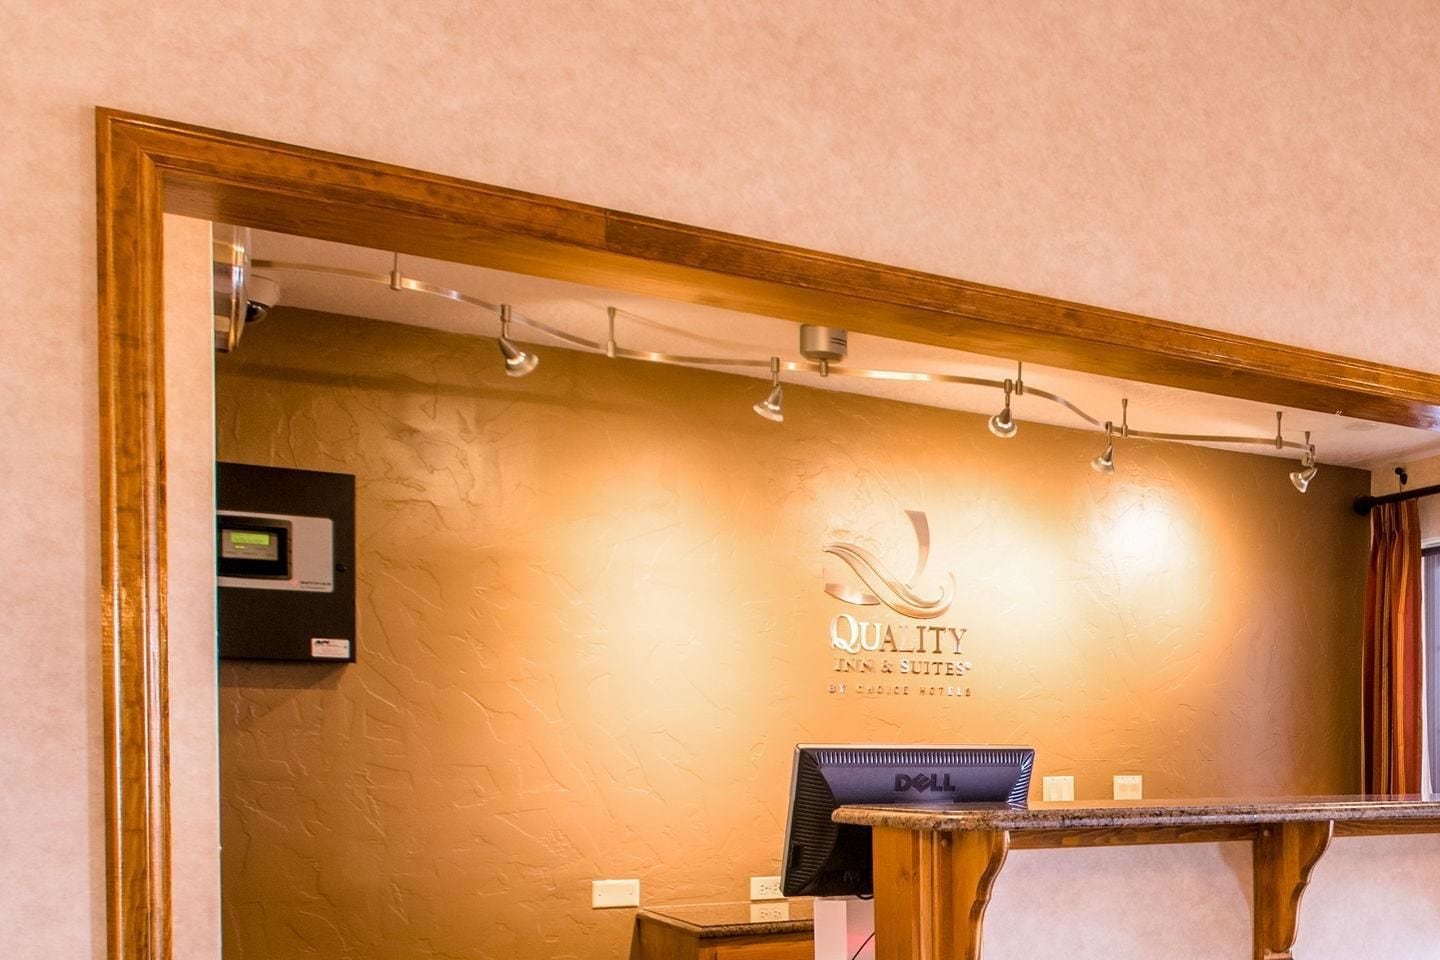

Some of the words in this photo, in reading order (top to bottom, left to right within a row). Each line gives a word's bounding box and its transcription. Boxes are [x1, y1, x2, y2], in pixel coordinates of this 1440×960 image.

[830, 613, 968, 655] QUALITY
[834, 658, 873, 673] INN
[881, 659, 894, 674] &
[900, 659, 966, 676] SUITES
[894, 772, 956, 793] DELL
